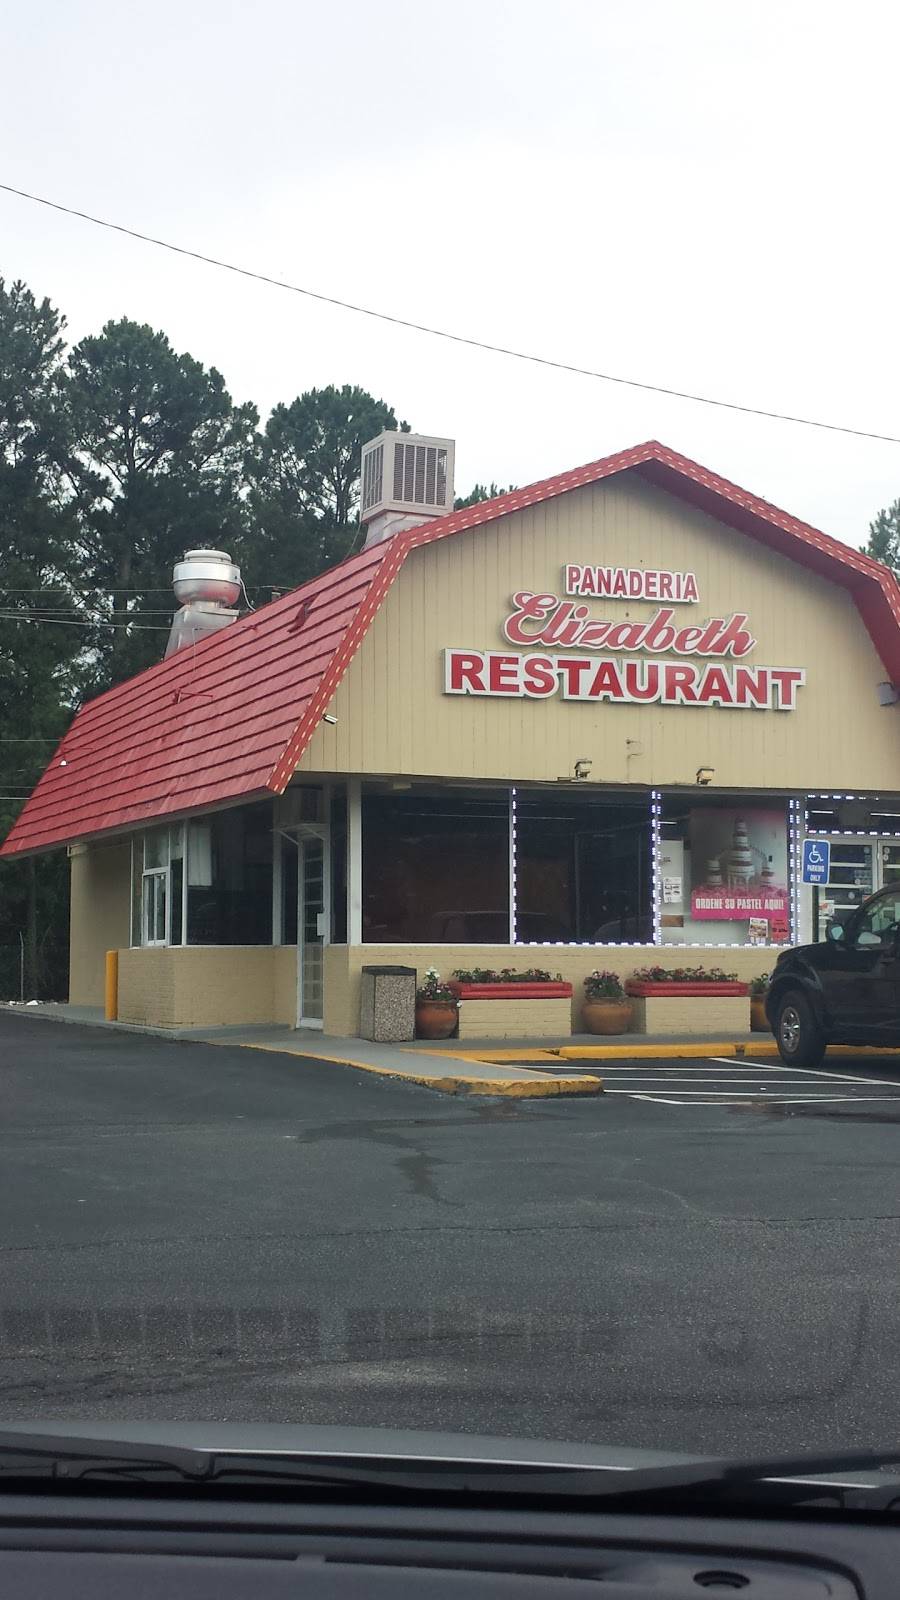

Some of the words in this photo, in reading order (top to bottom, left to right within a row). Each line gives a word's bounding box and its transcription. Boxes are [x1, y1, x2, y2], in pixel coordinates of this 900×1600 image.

[566, 566, 698, 601] PANADERIA
[505, 592, 756, 657] Elizabeth
[450, 653, 802, 706] RESTAURANT
[807, 865, 825, 873] PARKING
[809, 874, 821, 882] ONLY
[695, 898, 723, 910] ORDENE
[724, 898, 735, 910] SU
[736, 898, 762, 910] PASTEL
